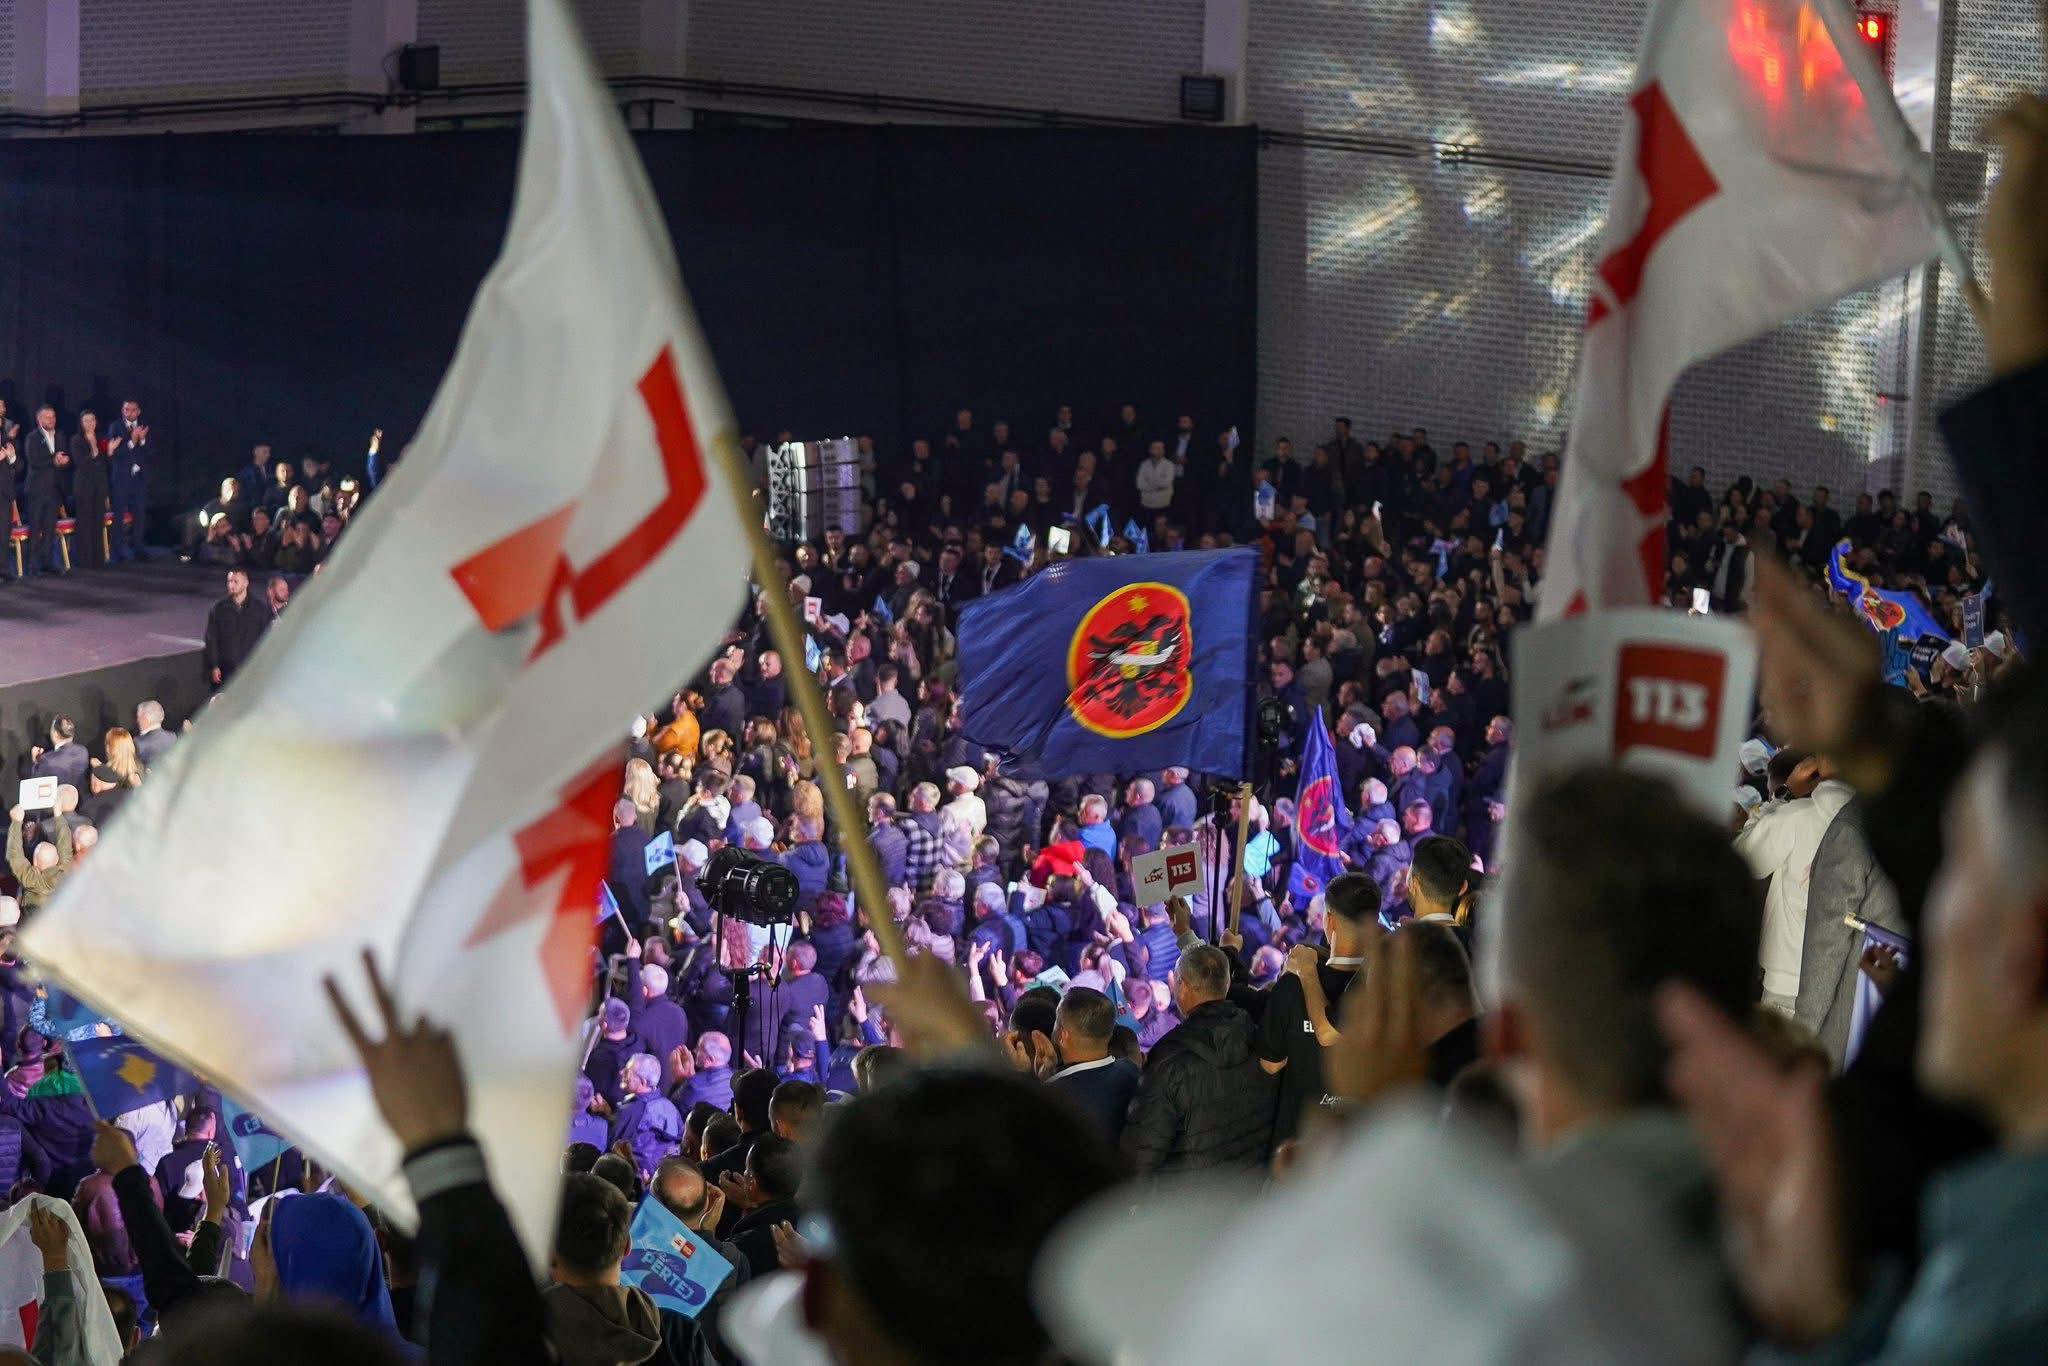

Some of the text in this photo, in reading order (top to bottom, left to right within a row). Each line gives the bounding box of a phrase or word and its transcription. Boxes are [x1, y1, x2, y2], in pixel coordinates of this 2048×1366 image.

[1629, 676, 1708, 731] 113
[1144, 862, 1192, 884] LDK 113
